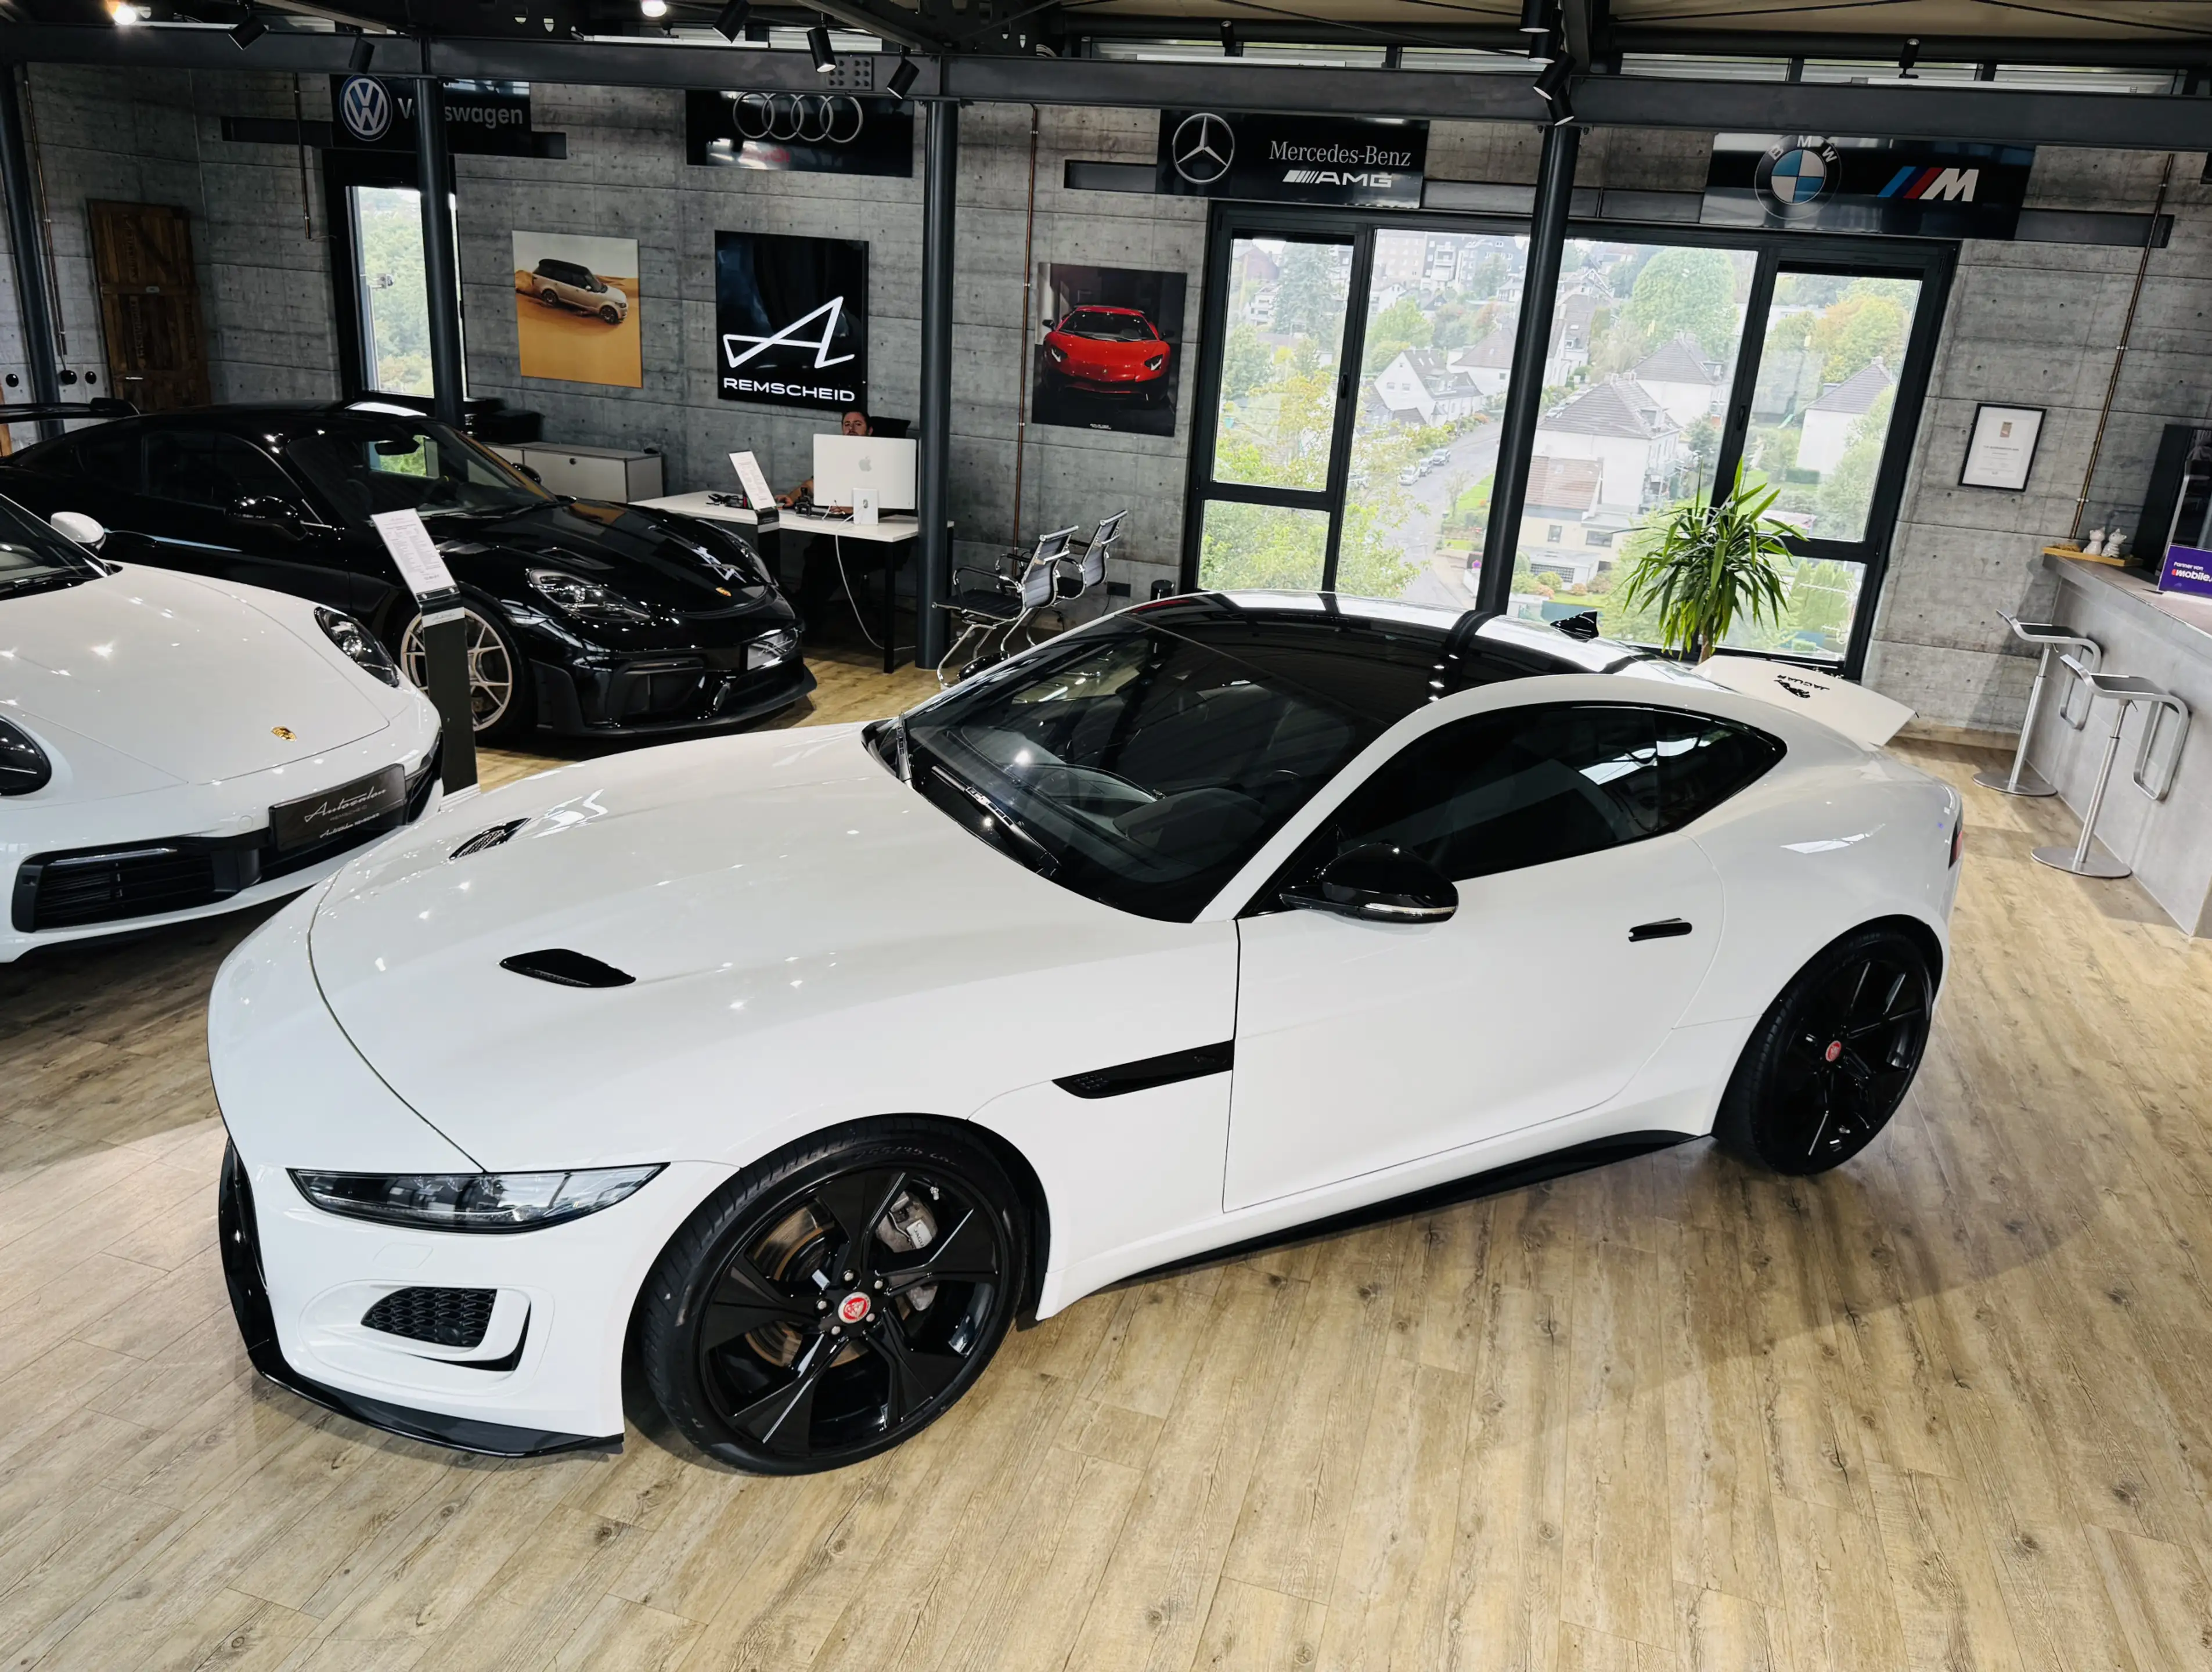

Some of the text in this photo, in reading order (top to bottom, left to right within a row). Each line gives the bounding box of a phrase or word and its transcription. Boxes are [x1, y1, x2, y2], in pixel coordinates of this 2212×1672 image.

[397, 98, 523, 129] Vswagen
[1269, 140, 1411, 167] Mercedes-Benz
[1768, 135, 1838, 163] BMW
[1315, 171, 1393, 188] AMG
[723, 377, 855, 402] REMSCHEID
[2171, 568, 2212, 582] mobile.
[1777, 675, 1830, 690] JAGUAR
[304, 786, 387, 823] Autosalon
